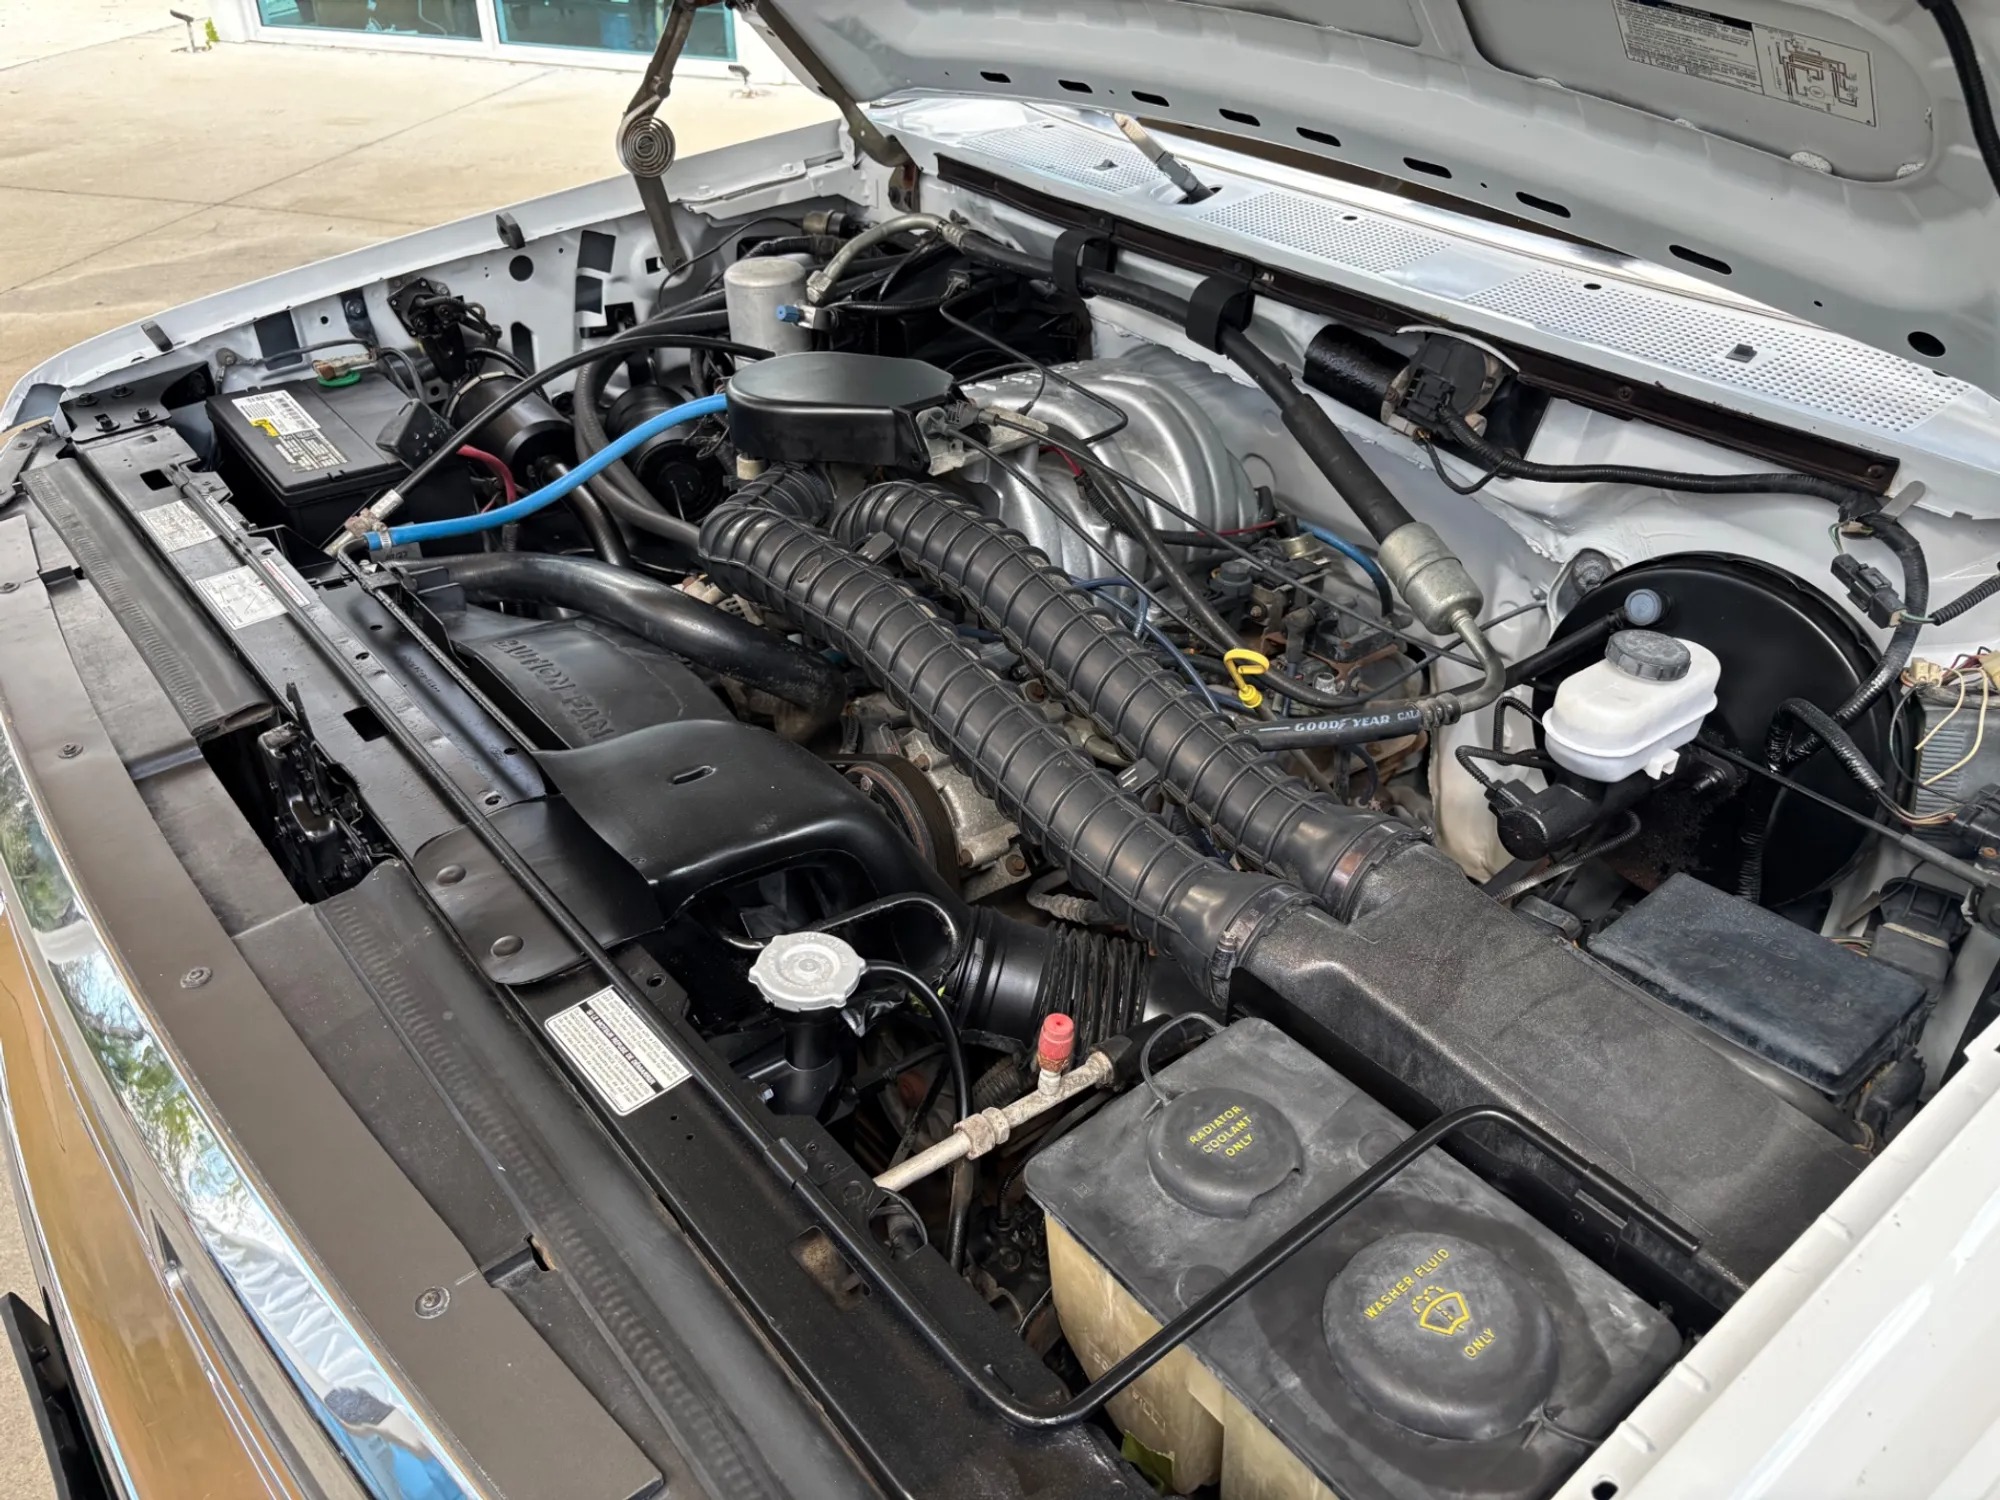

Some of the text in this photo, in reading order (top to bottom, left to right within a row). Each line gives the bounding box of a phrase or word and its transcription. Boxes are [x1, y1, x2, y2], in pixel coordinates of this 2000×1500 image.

[562, 696, 615, 738] FAN
[1189, 1105, 1242, 1145] RADIATOR
[1202, 1115, 1252, 1154] COOLANT
[1225, 1133, 1253, 1157] ONLY
[1364, 1248, 1450, 1319] WASHER FLUID
[1464, 1327, 1496, 1358] ONLY
